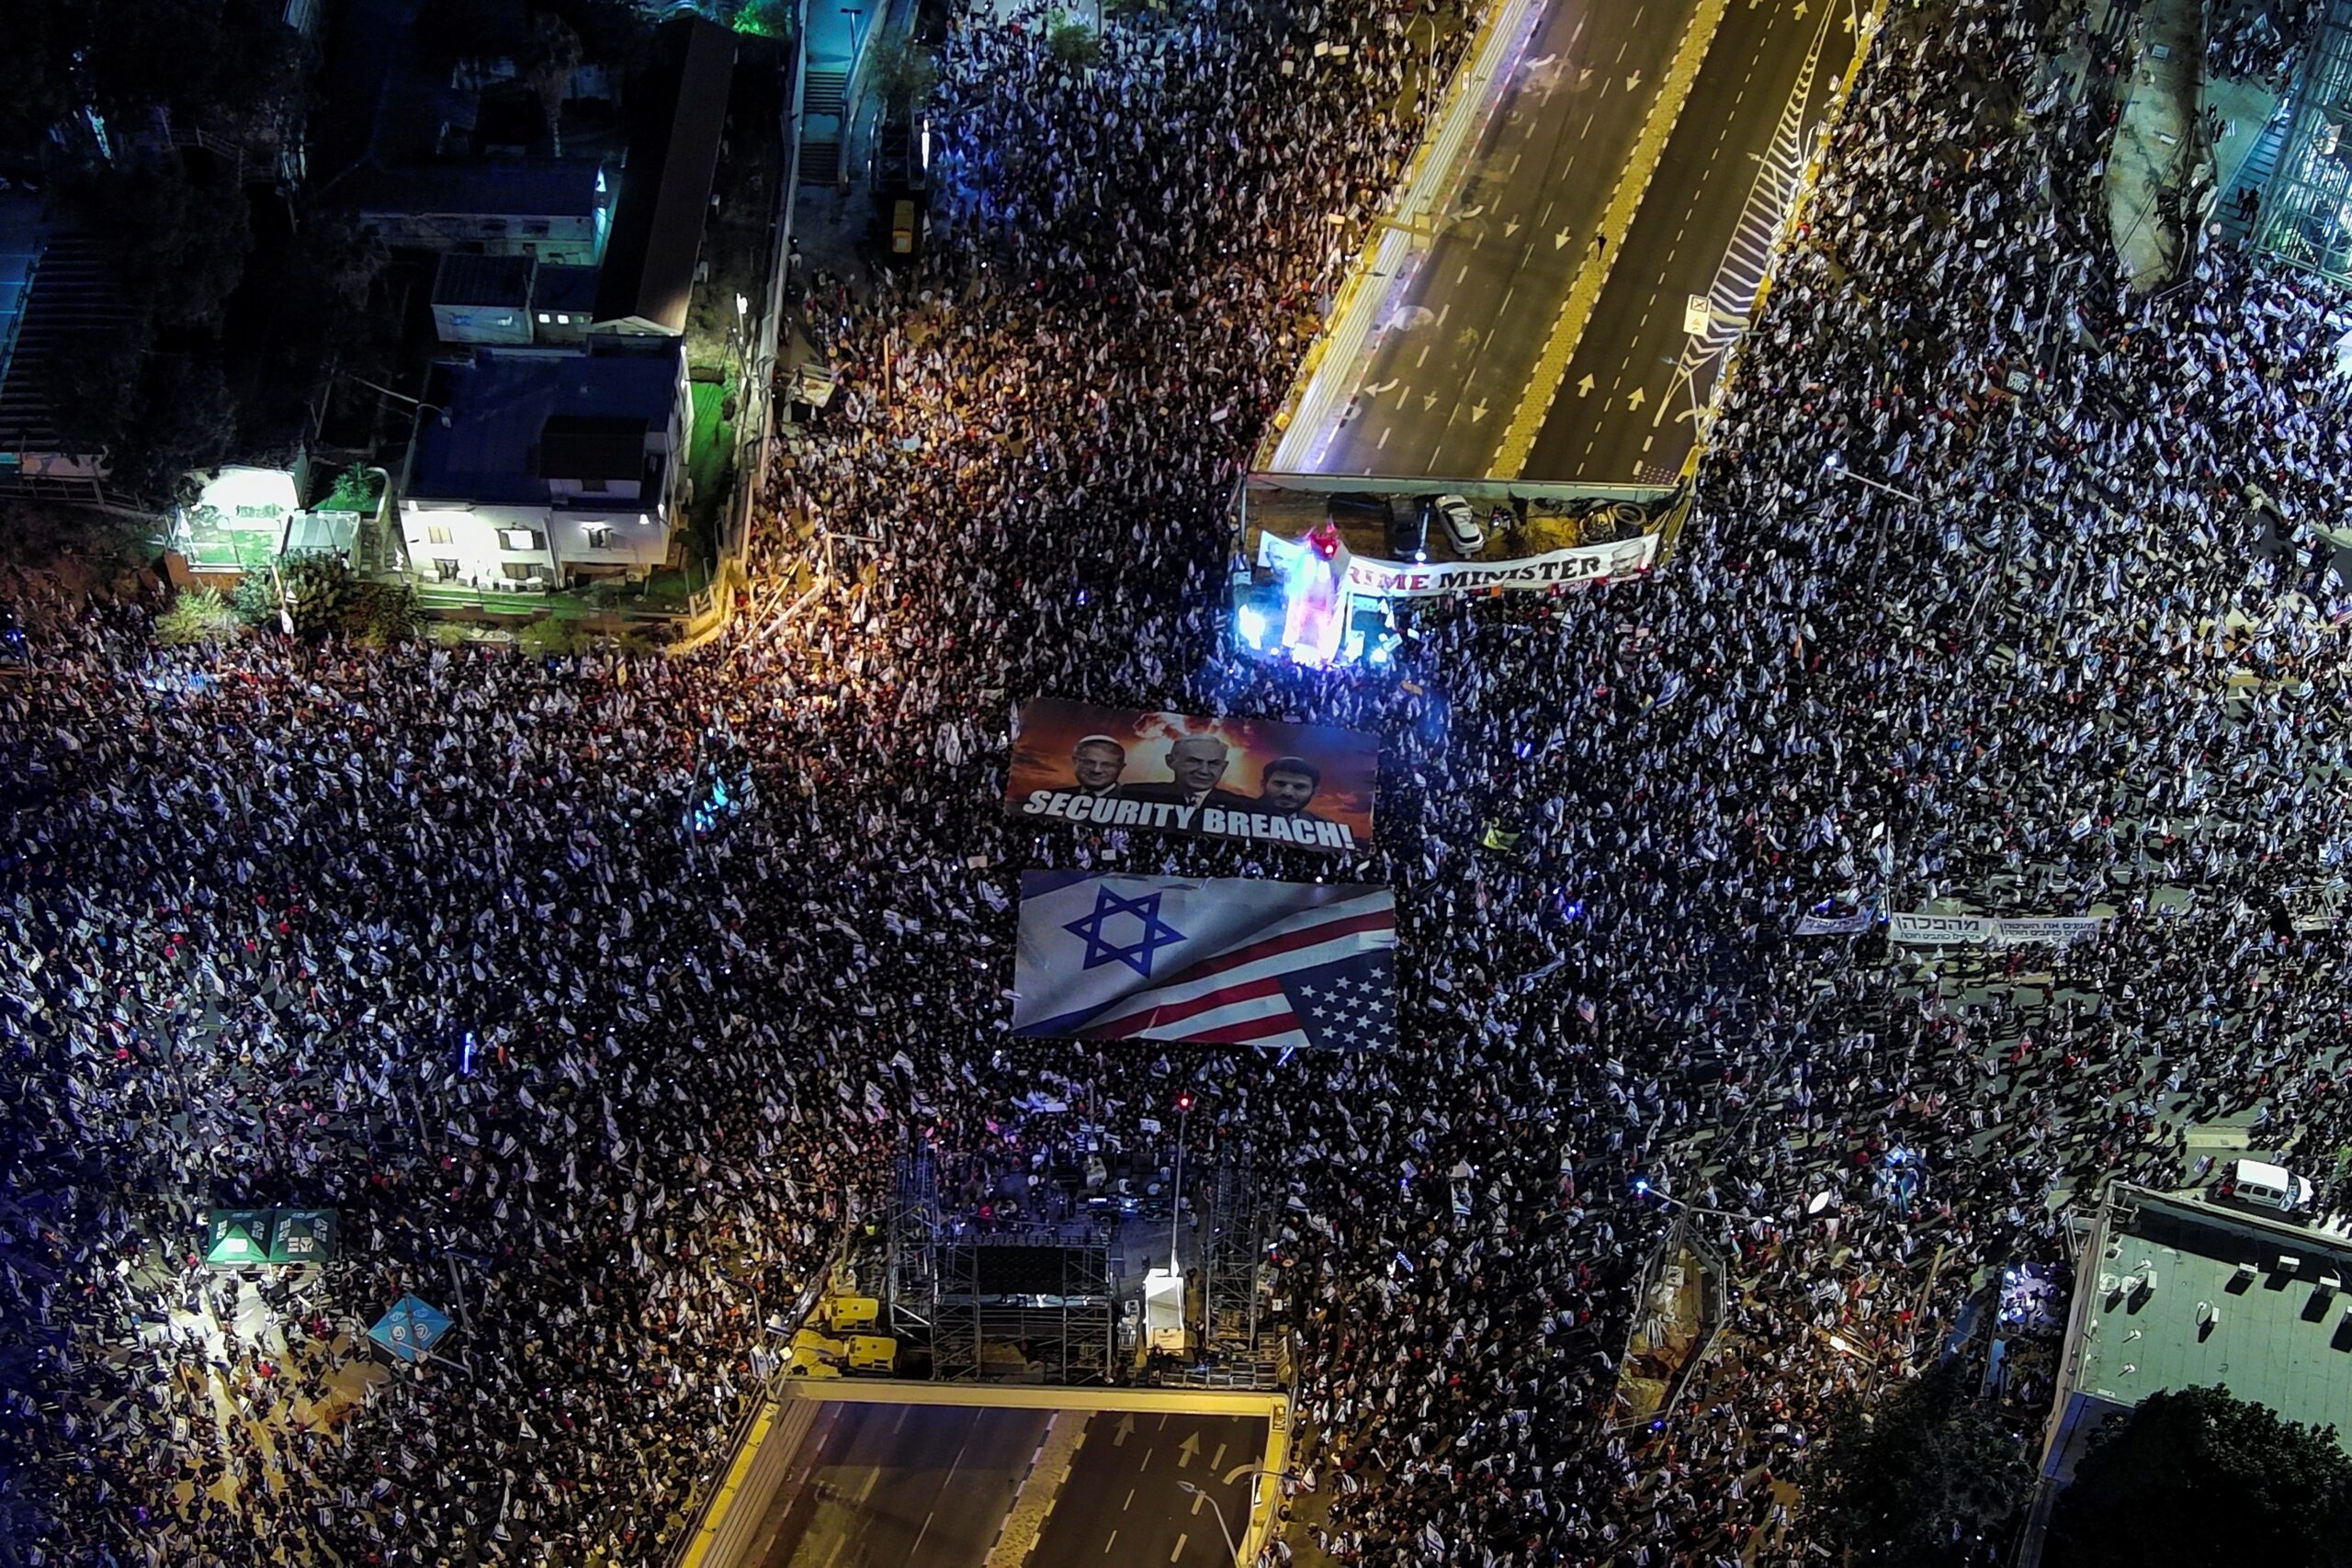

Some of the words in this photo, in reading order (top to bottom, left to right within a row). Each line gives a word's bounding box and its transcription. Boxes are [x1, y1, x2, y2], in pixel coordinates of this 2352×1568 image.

[1349, 566, 1430, 591] RIME
[1439, 557, 1600, 589] MINISTER
[1023, 790, 1196, 829] SECURITY
[1202, 808, 1356, 850] BREACH!
[1901, 917, 1980, 931] מהפכה
